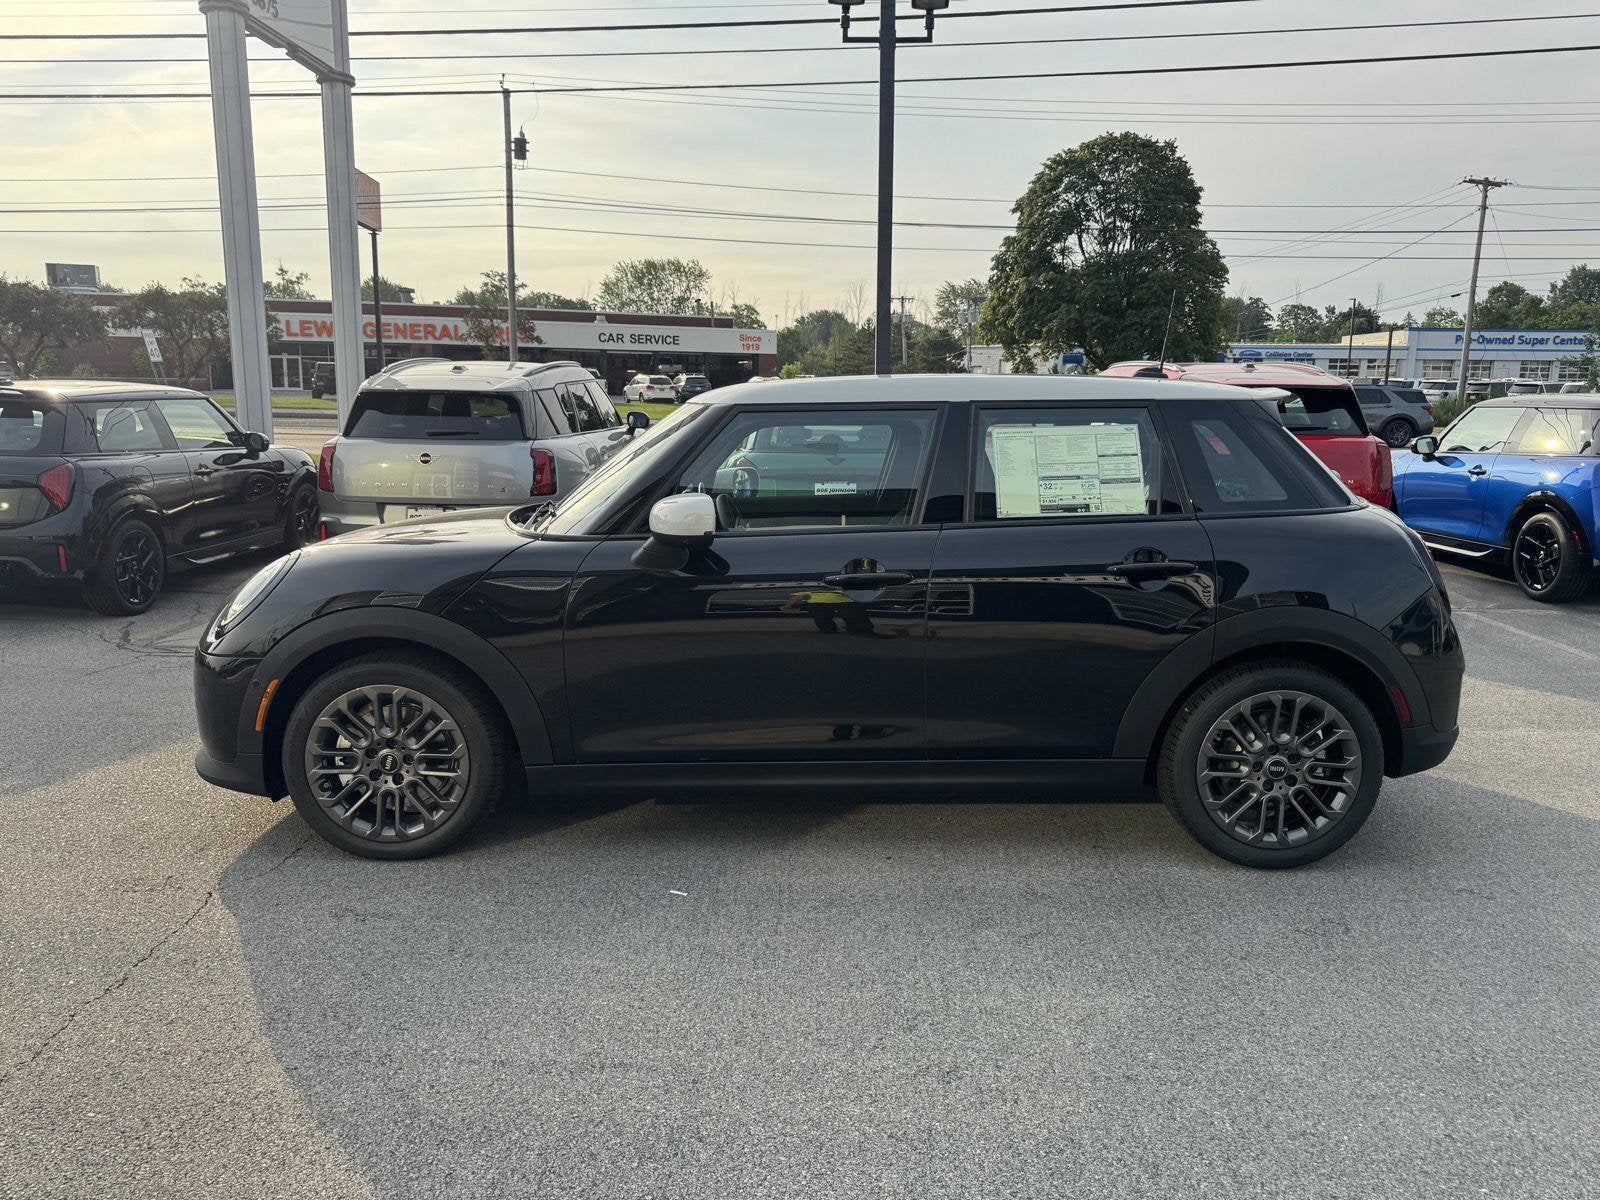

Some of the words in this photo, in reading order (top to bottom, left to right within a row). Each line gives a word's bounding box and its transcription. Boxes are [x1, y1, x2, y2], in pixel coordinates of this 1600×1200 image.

[285, 319, 333, 338] LEW
[362, 321, 466, 341] GENERAL
[598, 332, 625, 344] CAR
[629, 333, 680, 346] SERVICE
[739, 334, 762, 343] Since
[1517, 335, 1550, 347] Super
[1552, 335, 1585, 346] Cente
[741, 343, 760, 351] 1919
